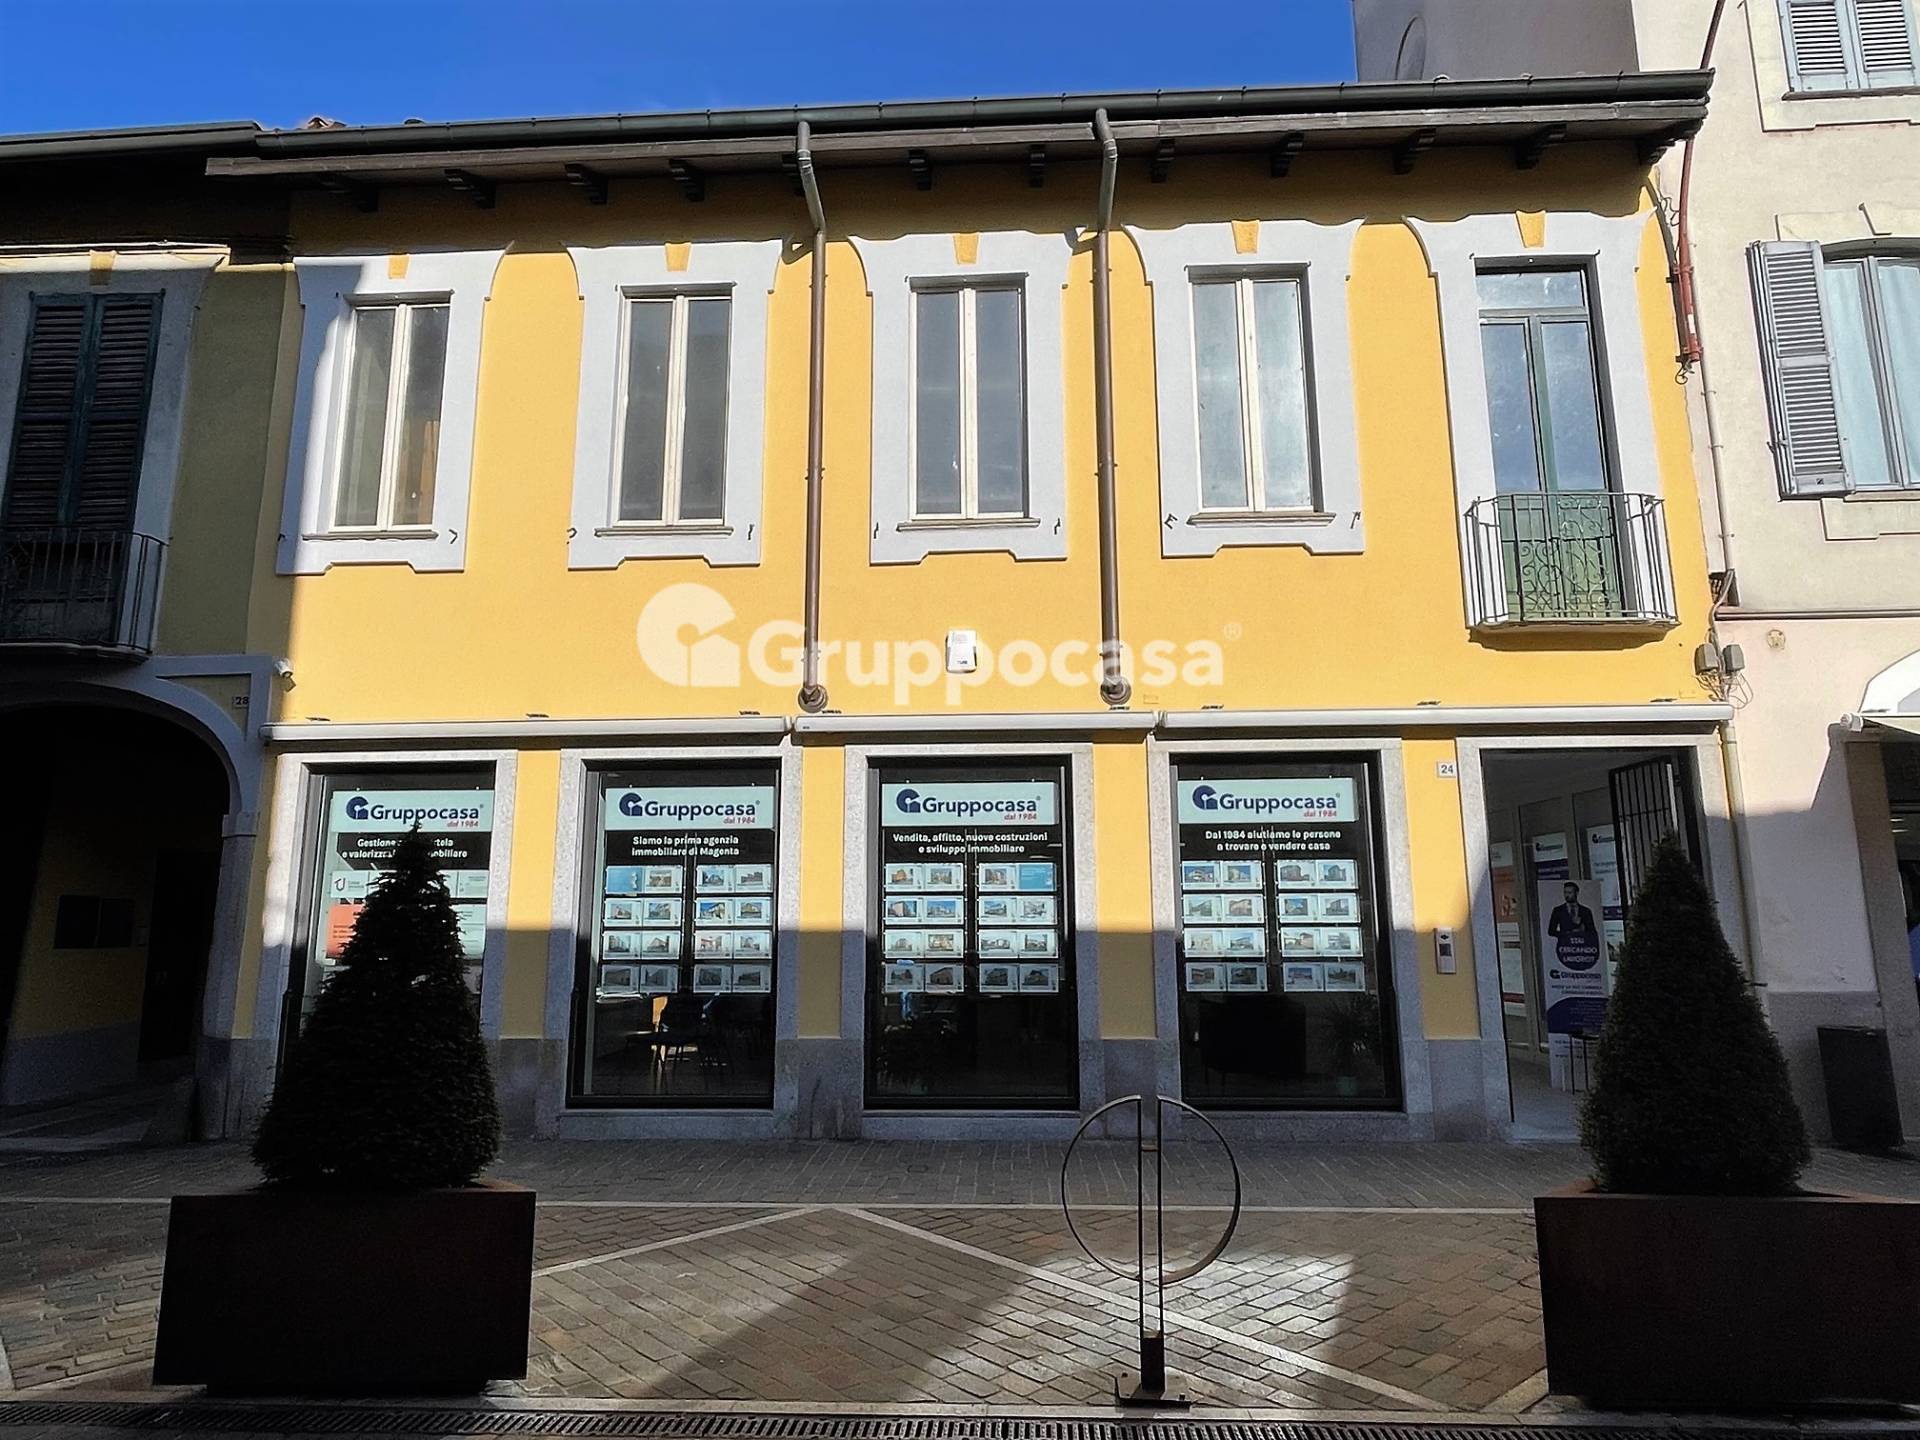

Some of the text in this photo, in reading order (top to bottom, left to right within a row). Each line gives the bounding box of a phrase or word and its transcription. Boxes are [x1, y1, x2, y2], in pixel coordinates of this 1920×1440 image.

[235, 696, 249, 705] 28
[1440, 764, 1454, 774] 24
[922, 798, 1037, 817] Gruppocasa
[1219, 793, 1337, 814] Gruppocasa
[370, 804, 479, 824] Gruppocasa
[644, 800, 756, 821] Gruppocasa
[1303, 809, 1337, 817] dal 1984
[723, 816, 756, 824] dal 1984
[1003, 813, 1017, 821] dal
[893, 832, 1048, 843] Vendita, affitto, nuove costruzioni
[1205, 830, 1222, 839] Dal
[1223, 830, 1246, 839] 1984
[1247, 830, 1290, 839] aiutiamo
[1303, 831, 1341, 840] persone
[632, 835, 739, 847] Siamo la prima agenzia
[1225, 842, 1260, 851] trovare
[1268, 842, 1305, 850] vendere
[1307, 842, 1331, 850] casa
[631, 847, 687, 856] immobiliare
[699, 847, 740, 858] Magenta
[926, 844, 967, 855] sviluppo
[967, 844, 1025, 853] immobiliare
